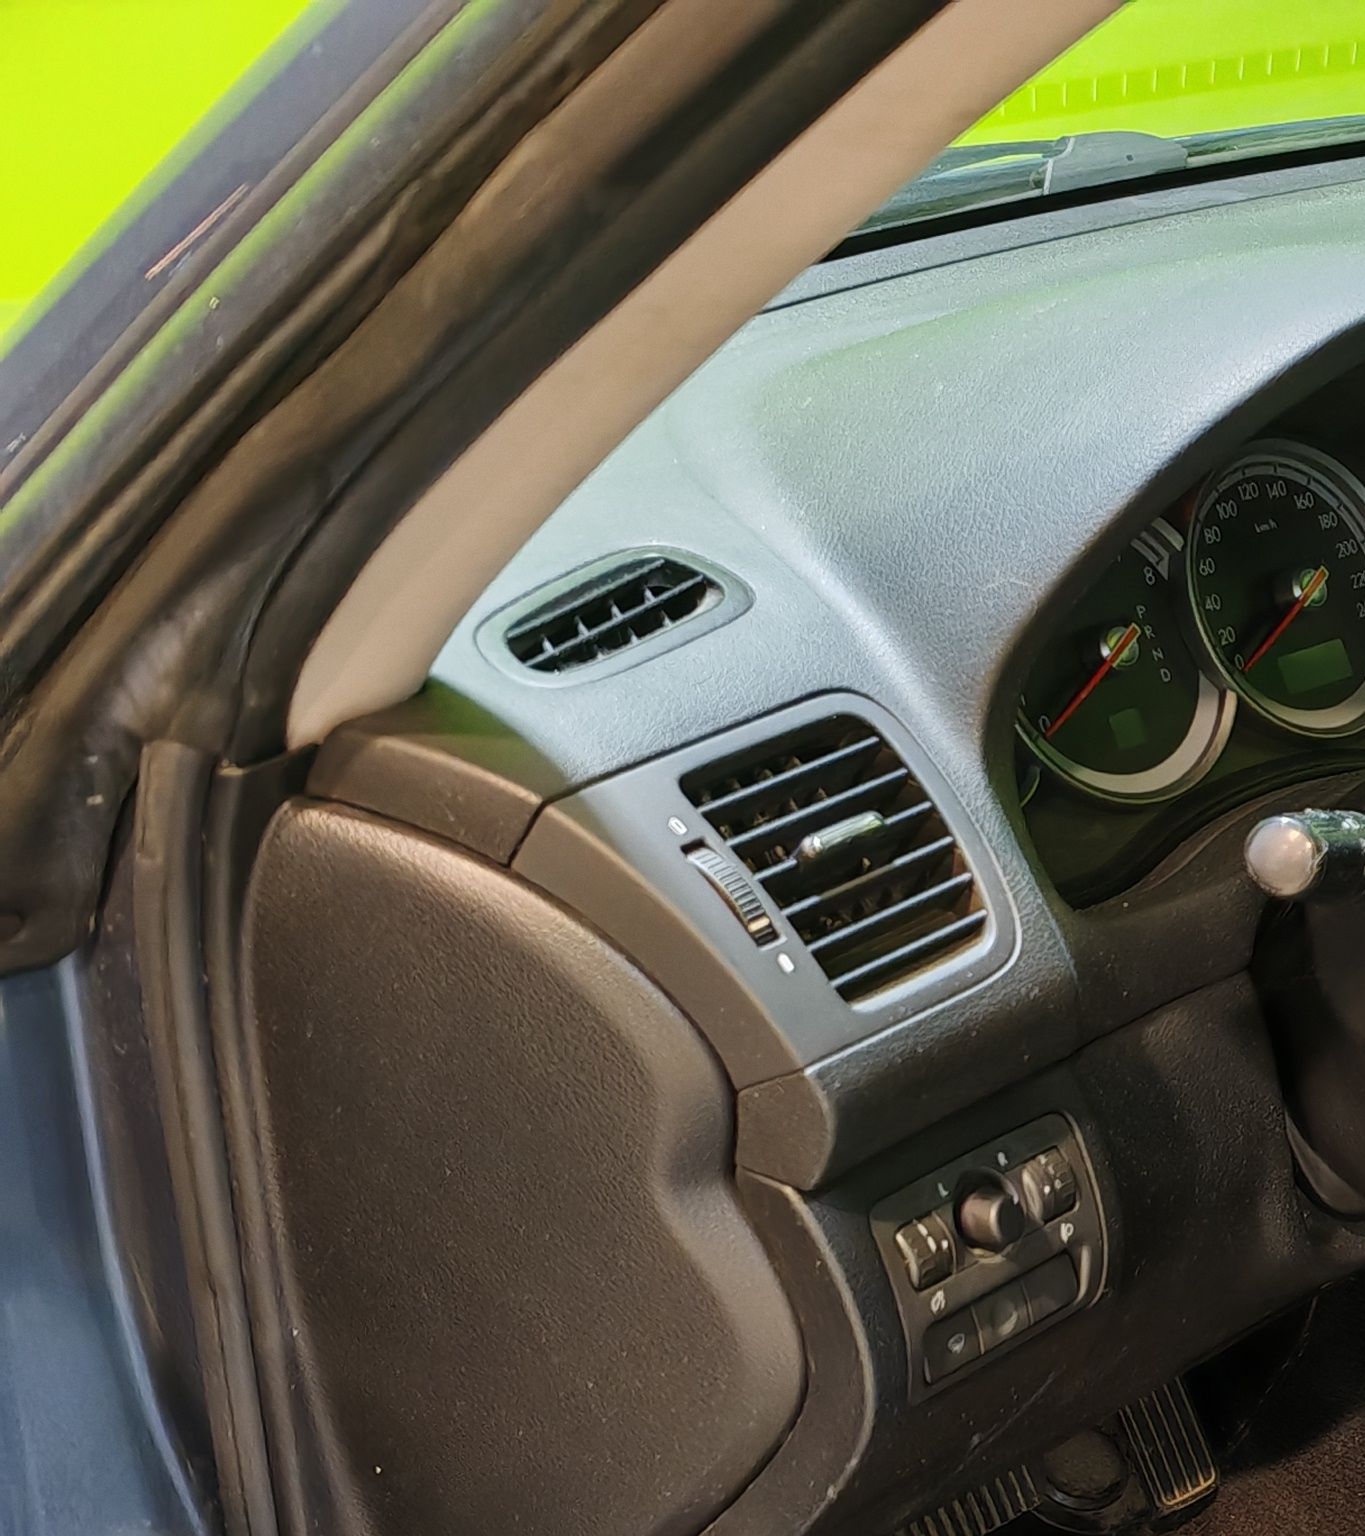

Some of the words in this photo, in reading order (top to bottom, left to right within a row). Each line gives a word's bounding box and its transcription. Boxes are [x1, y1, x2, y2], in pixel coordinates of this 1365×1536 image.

[1239, 482, 1259, 500] 120
[1267, 481, 1287, 499] 140
[1216, 500, 1237, 520] 100
[1295, 492, 1315, 510] 160
[1319, 512, 1338, 531] 180
[1204, 526, 1221, 544] 80
[1336, 540, 1358, 558] 200
[1144, 567, 1156, 585] 8
[1200, 558, 1215, 576] 60
[1205, 594, 1220, 610] 40
[1136, 605, 1147, 619] P
[1144, 626, 1155, 639] R
[1218, 626, 1236, 645] 20
[1152, 648, 1164, 661] N
[1234, 654, 1244, 670] 0
[1160, 668, 1171, 682] D
[1039, 715, 1051, 732] 0
